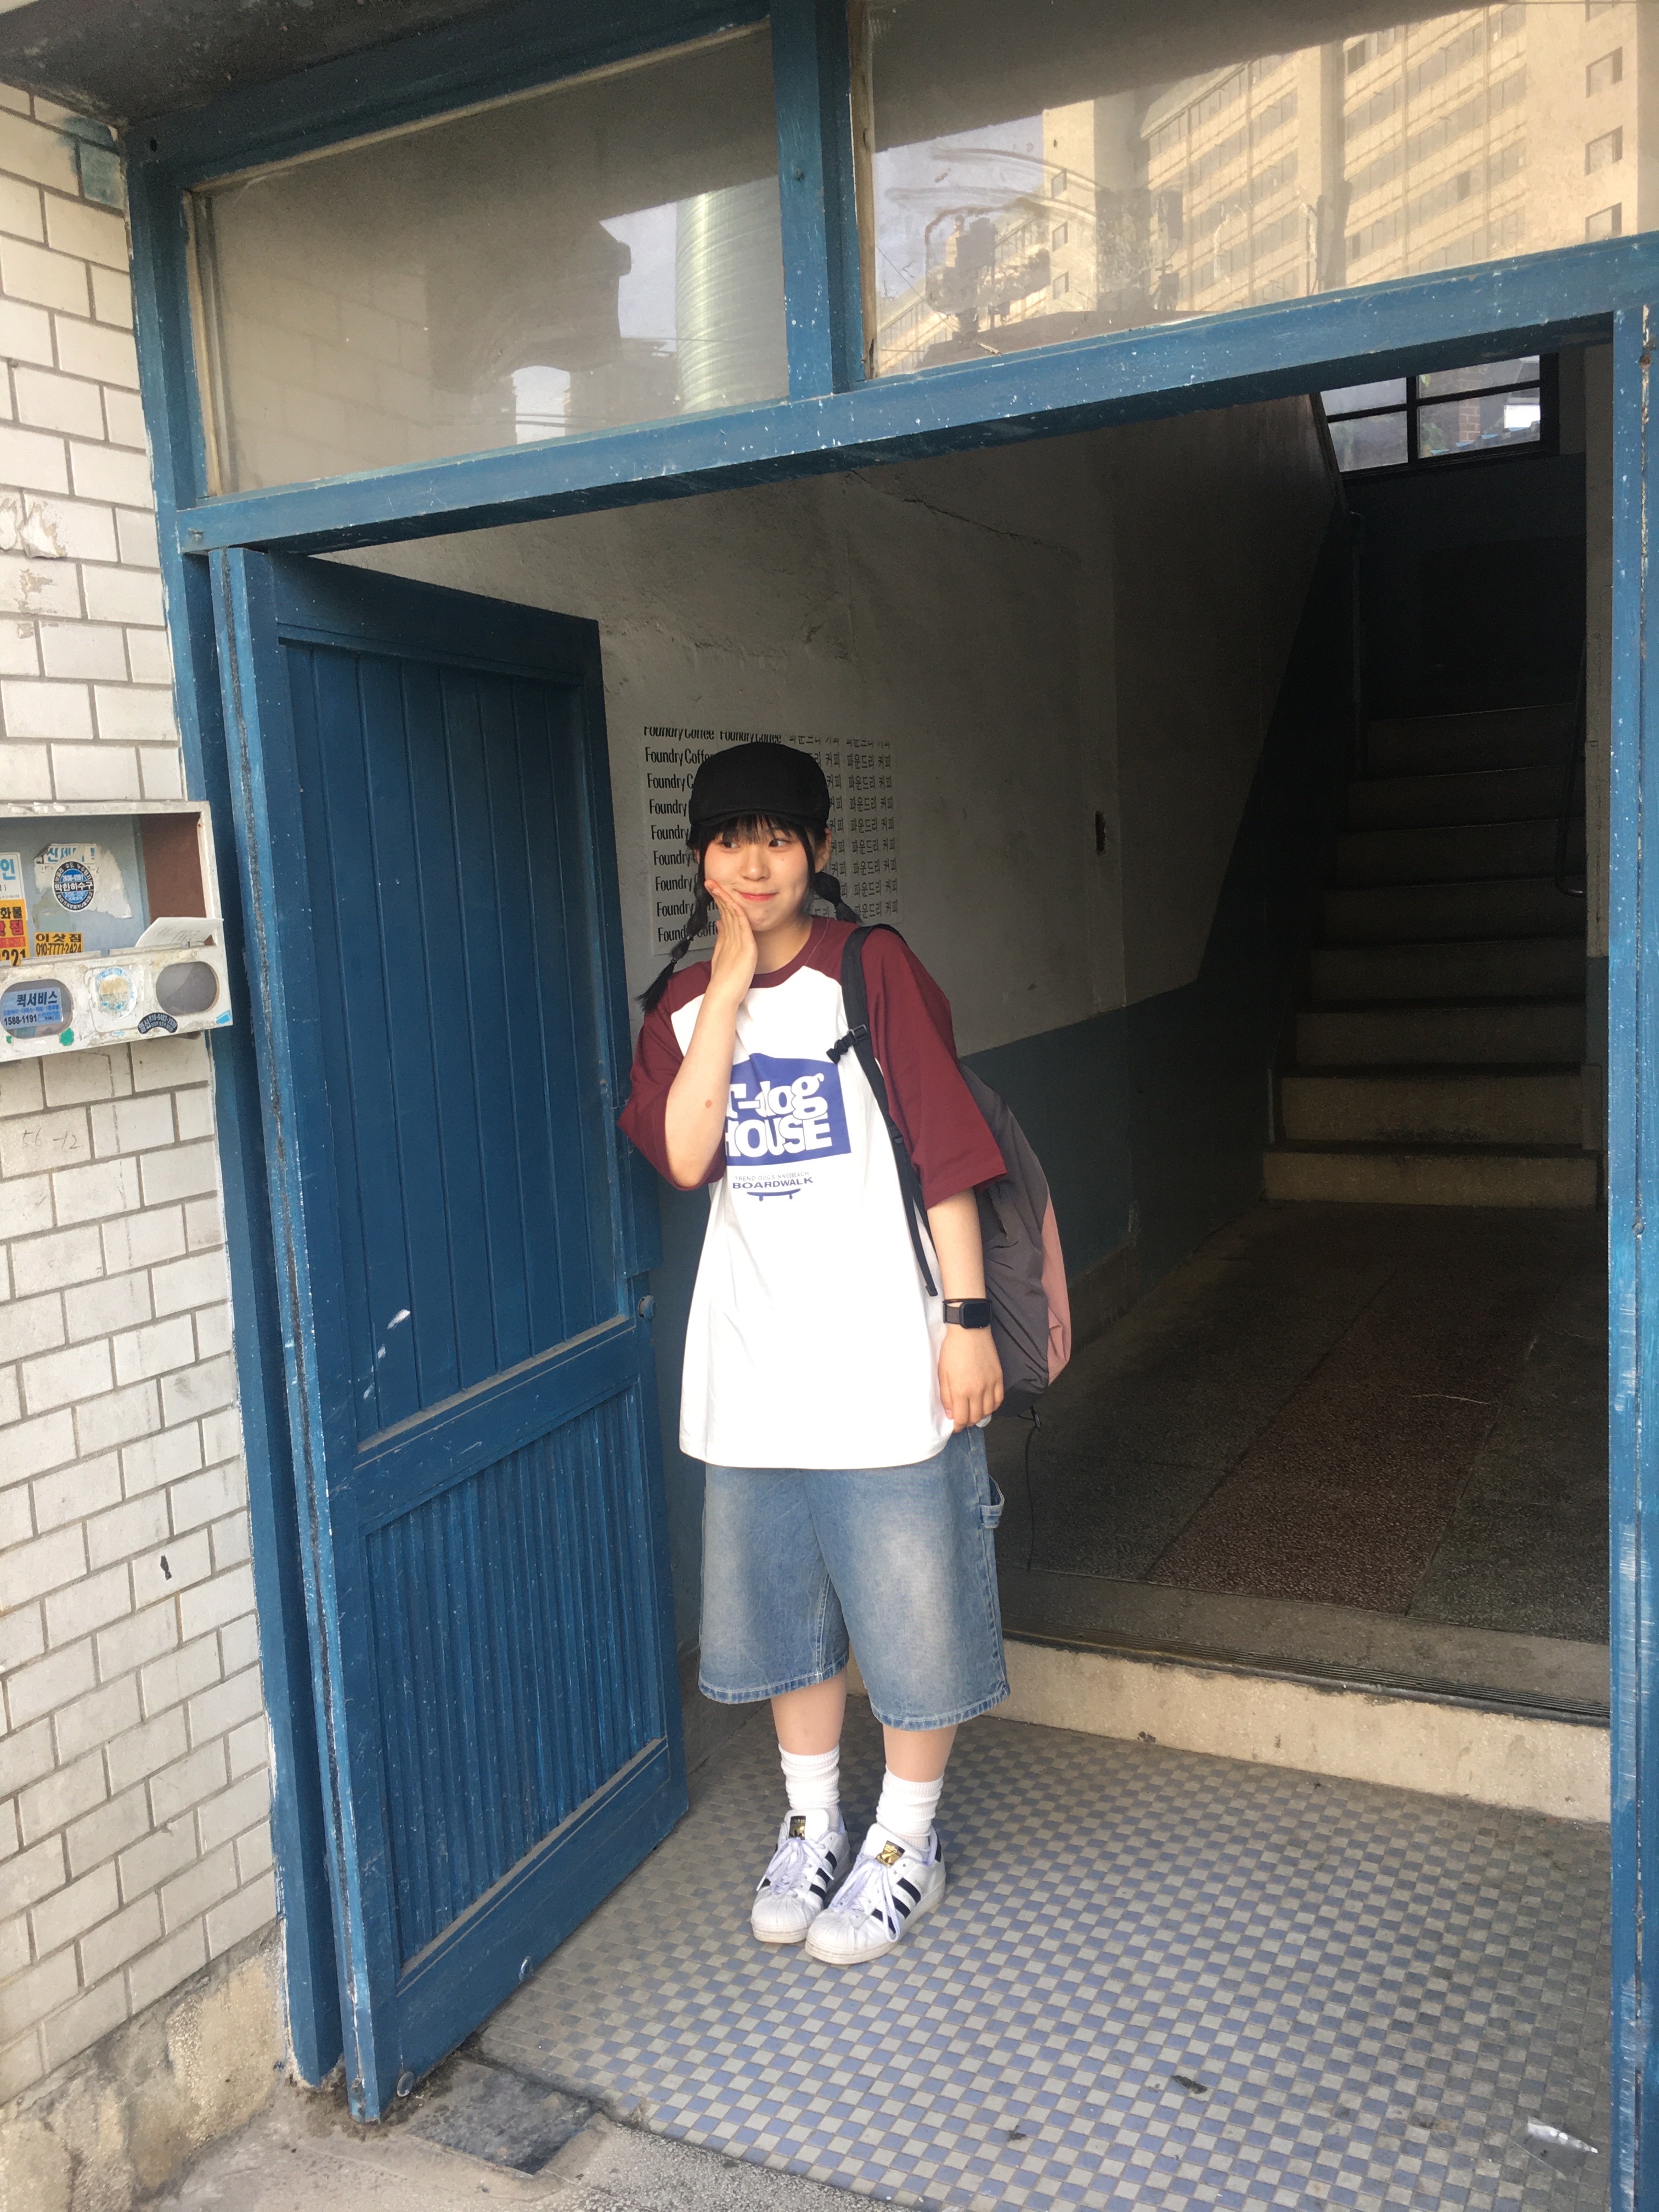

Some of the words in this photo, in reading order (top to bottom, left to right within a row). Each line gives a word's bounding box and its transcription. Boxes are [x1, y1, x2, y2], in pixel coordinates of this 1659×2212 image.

[645, 747, 683, 766] Foundry
[825, 752, 840, 768] 커피
[847, 753, 874, 769] 파운드리
[878, 754, 891, 769] 커피
[647, 772, 685, 792] Foundry
[827, 774, 842, 789] 커피
[848, 775, 875, 791] 파운드리
[879, 775, 892, 789] 커피
[649, 799, 687, 817] Foundry
[849, 796, 877, 812] 파운드리
[881, 796, 893, 810] 커피
[830, 818, 844, 833] 커피
[851, 817, 878, 833] 파운드리
[881, 816, 894, 832] 커피
[651, 825, 689, 841] Foundry
[852, 838, 879, 855] 파운드리
[882, 837, 895, 852] 커피
[653, 850, 690, 867] Foundry
[832, 861, 847, 877] 커피
[853, 859, 881, 876] 파운드리
[884, 858, 897, 873] 커피
[55, 882, 93, 892] 막힌하수구
[655, 874, 692, 891] Foundry
[854, 880, 881, 898] 파운드리
[885, 878, 898, 894] 커피
[657, 900, 693, 917] Foundry
[885, 899, 898, 916] 커피
[658, 925, 686, 942] Found
[16, 991, 58, 1007] 퀵서비스
[4, 1014, 37, 1026] 1588-1191
[732, 1177, 814, 1189] BOARDWALK
